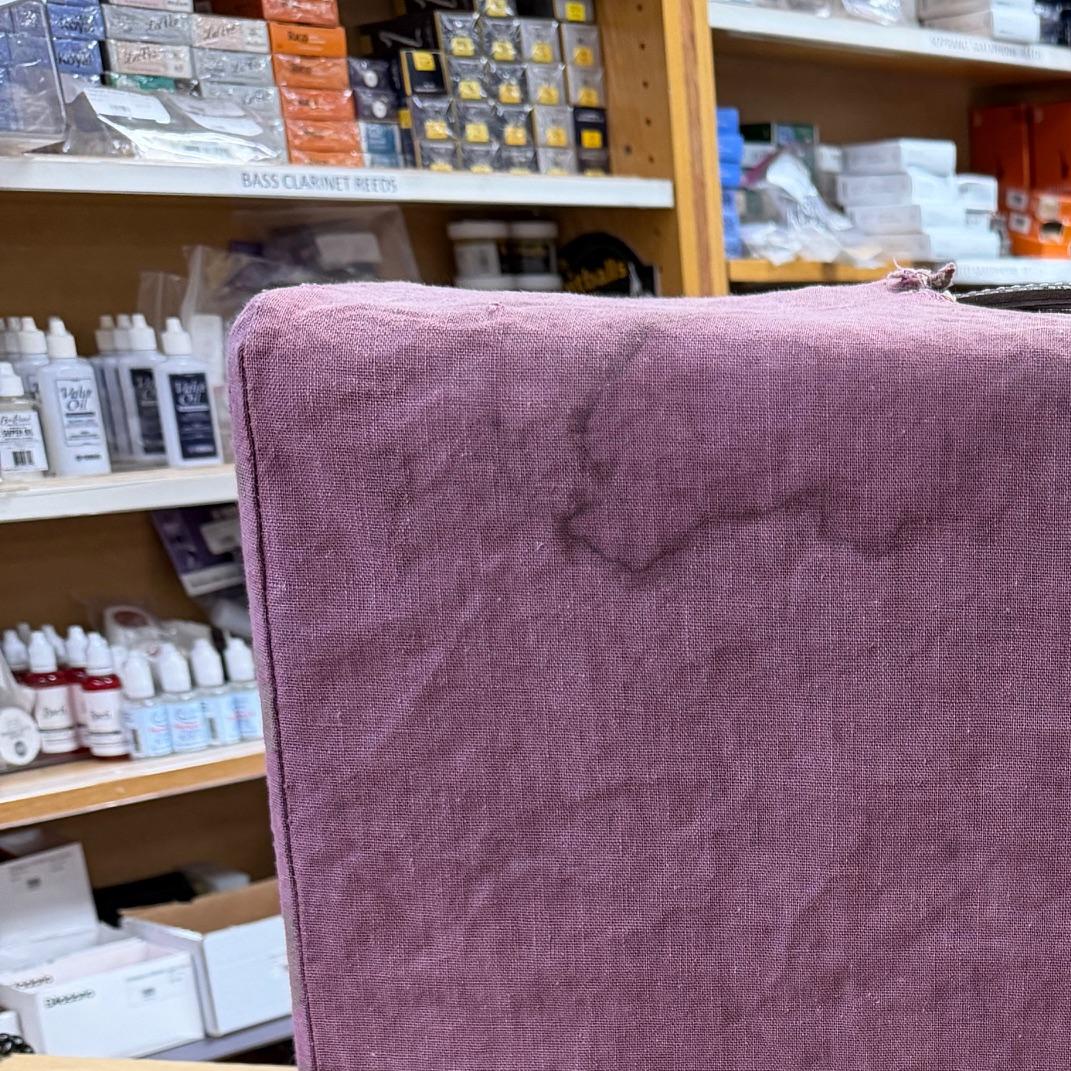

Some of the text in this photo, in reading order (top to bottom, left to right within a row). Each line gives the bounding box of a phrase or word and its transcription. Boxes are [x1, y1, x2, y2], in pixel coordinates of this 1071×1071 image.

[241, 172, 399, 193] BASS CLARINET REEDS
[67, 396, 89, 412] Oil
